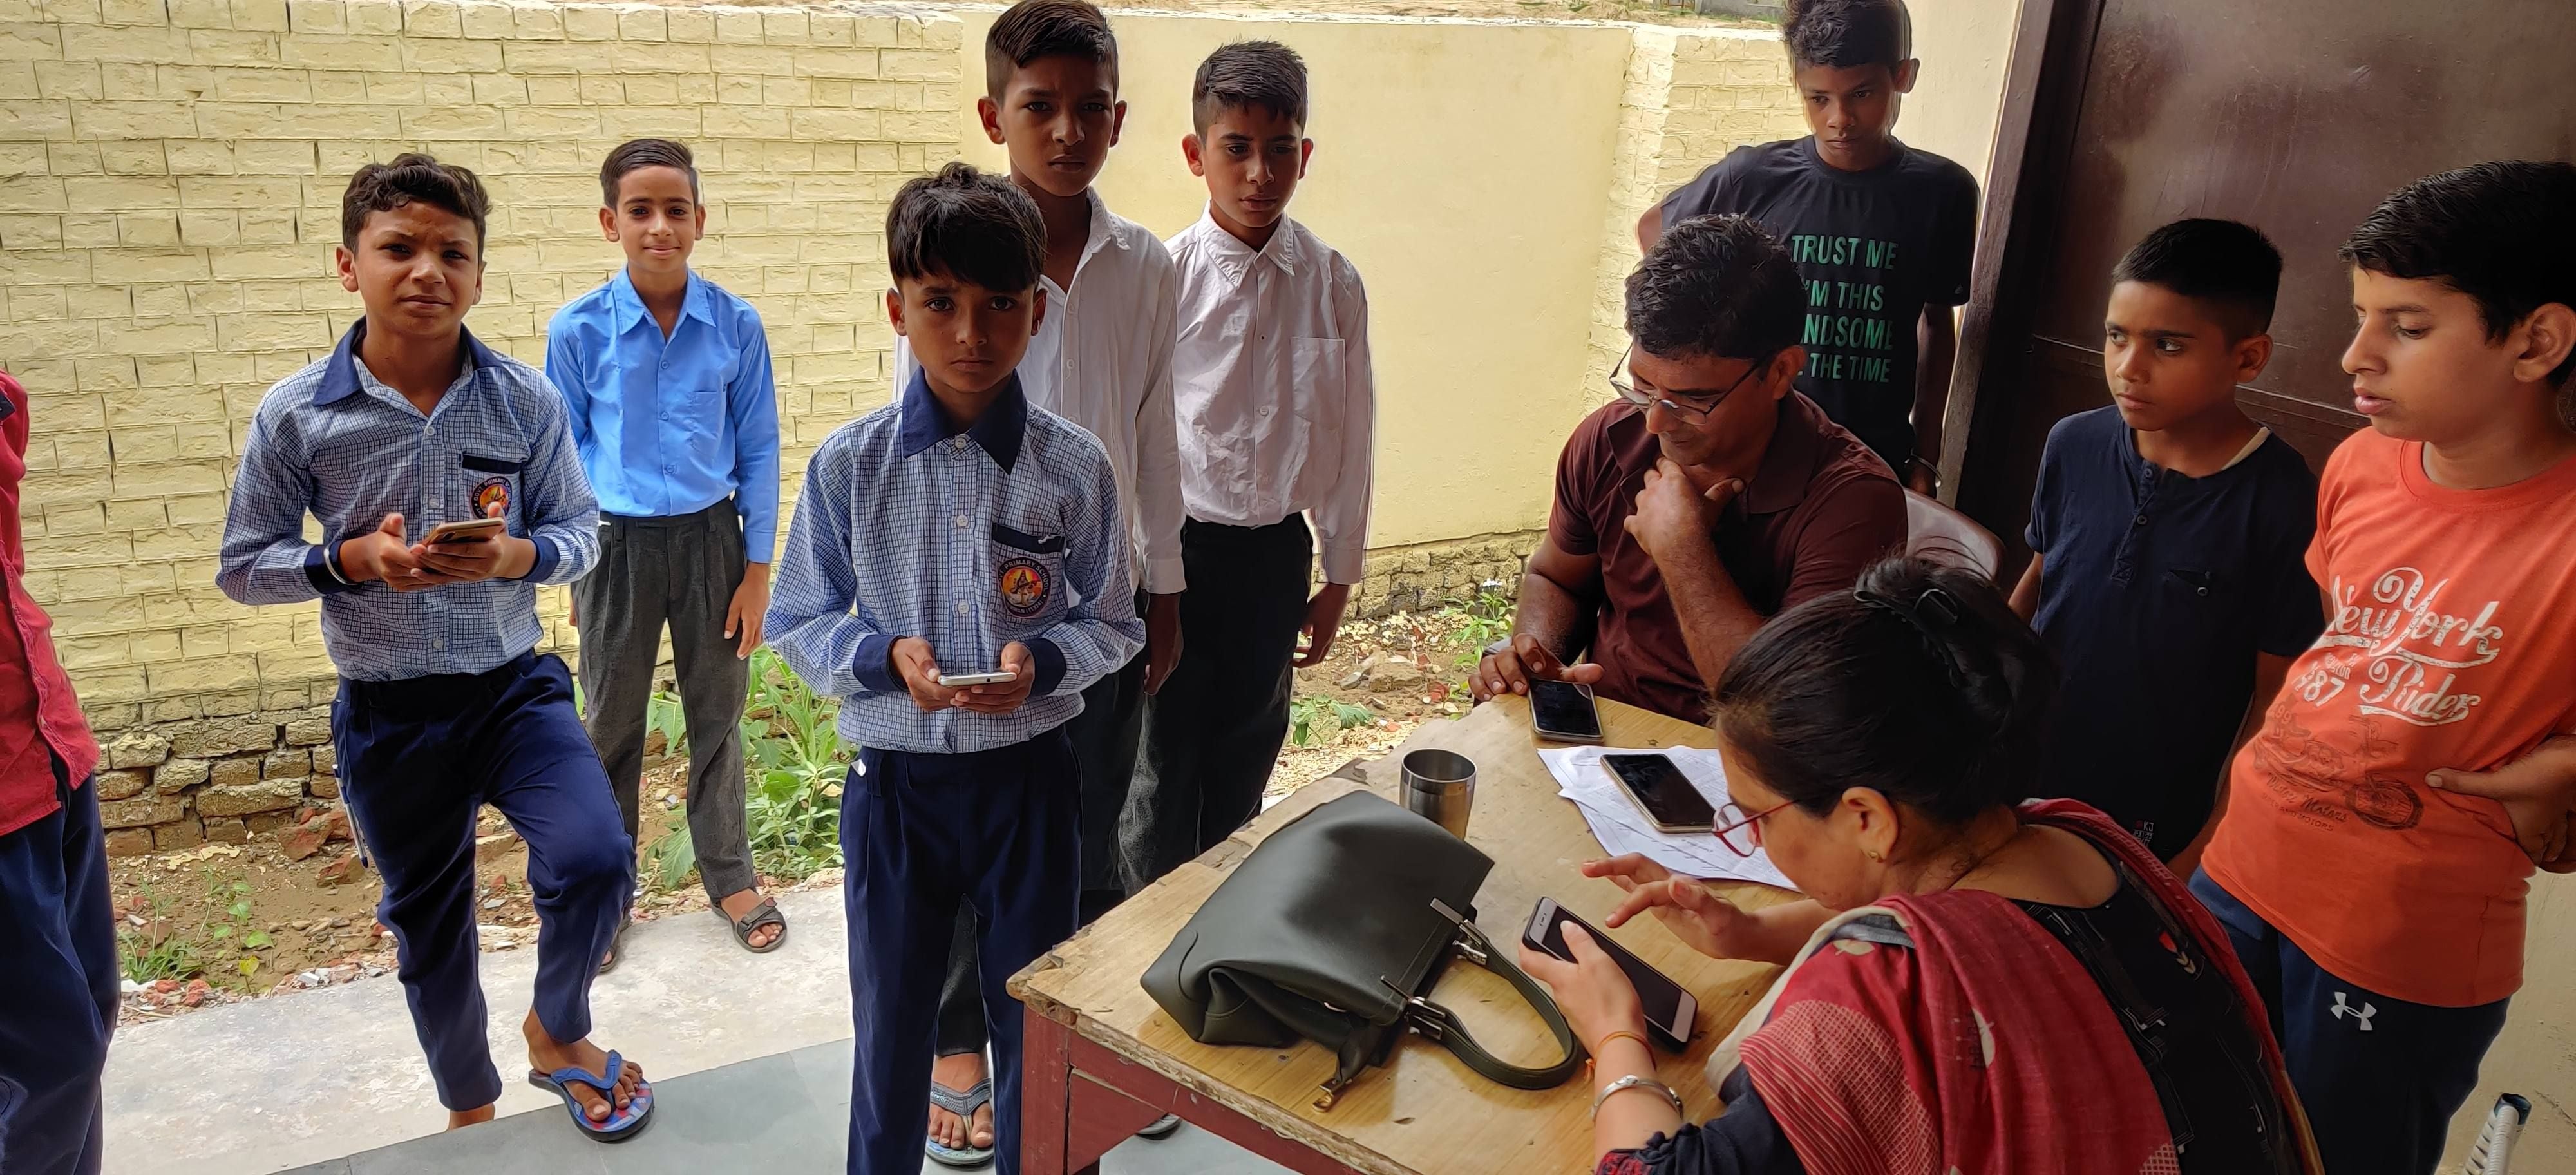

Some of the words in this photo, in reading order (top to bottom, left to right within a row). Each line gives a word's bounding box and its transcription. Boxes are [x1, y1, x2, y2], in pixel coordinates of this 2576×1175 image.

[1791, 235, 1861, 266] TRUST
[1865, 239, 1899, 270] ME
[1803, 279, 1830, 307] 'M
[1837, 281, 1884, 312] THIS
[1800, 314, 1893, 350] NDSOME
[1810, 352, 1843, 379] THE
[1849, 356, 1891, 383] TIME
[1004, 559, 1036, 569] PRIMARY
[1035, 566, 1050, 591] SCHOOL
[2370, 567, 2503, 662] York
[2360, 655, 2481, 720] Rider
